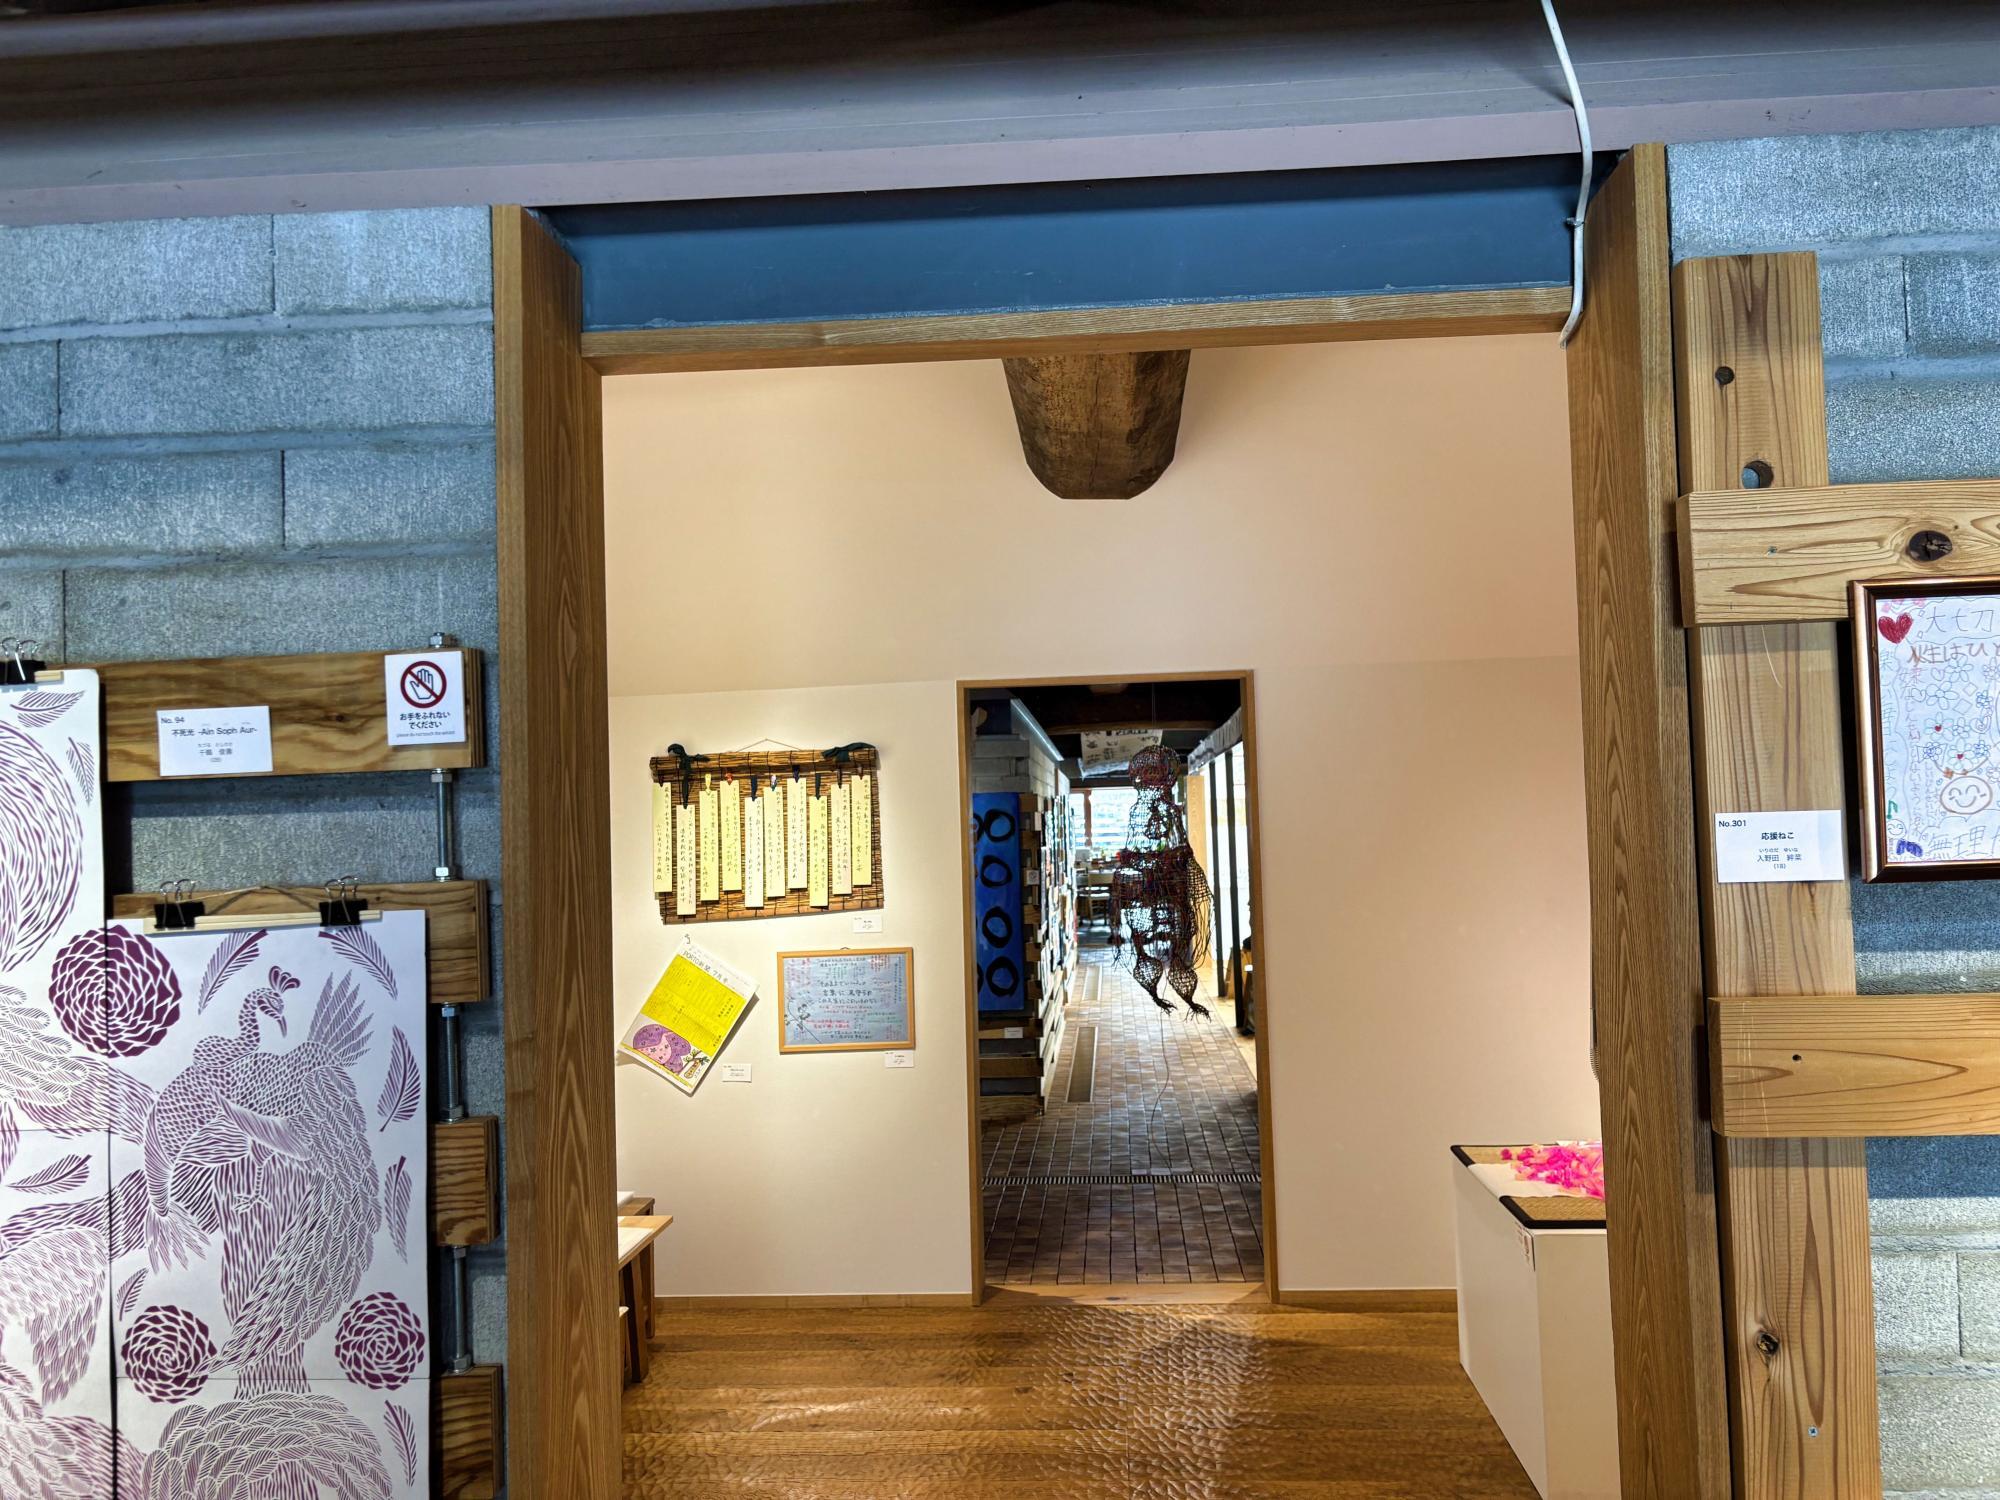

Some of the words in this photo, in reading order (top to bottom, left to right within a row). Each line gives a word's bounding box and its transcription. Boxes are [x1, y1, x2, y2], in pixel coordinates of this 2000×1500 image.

[399, 711, 451, 721] お手をふれない
[408, 721, 442, 729] でください
[1761, 832, 1795, 841] 応援ねこ
